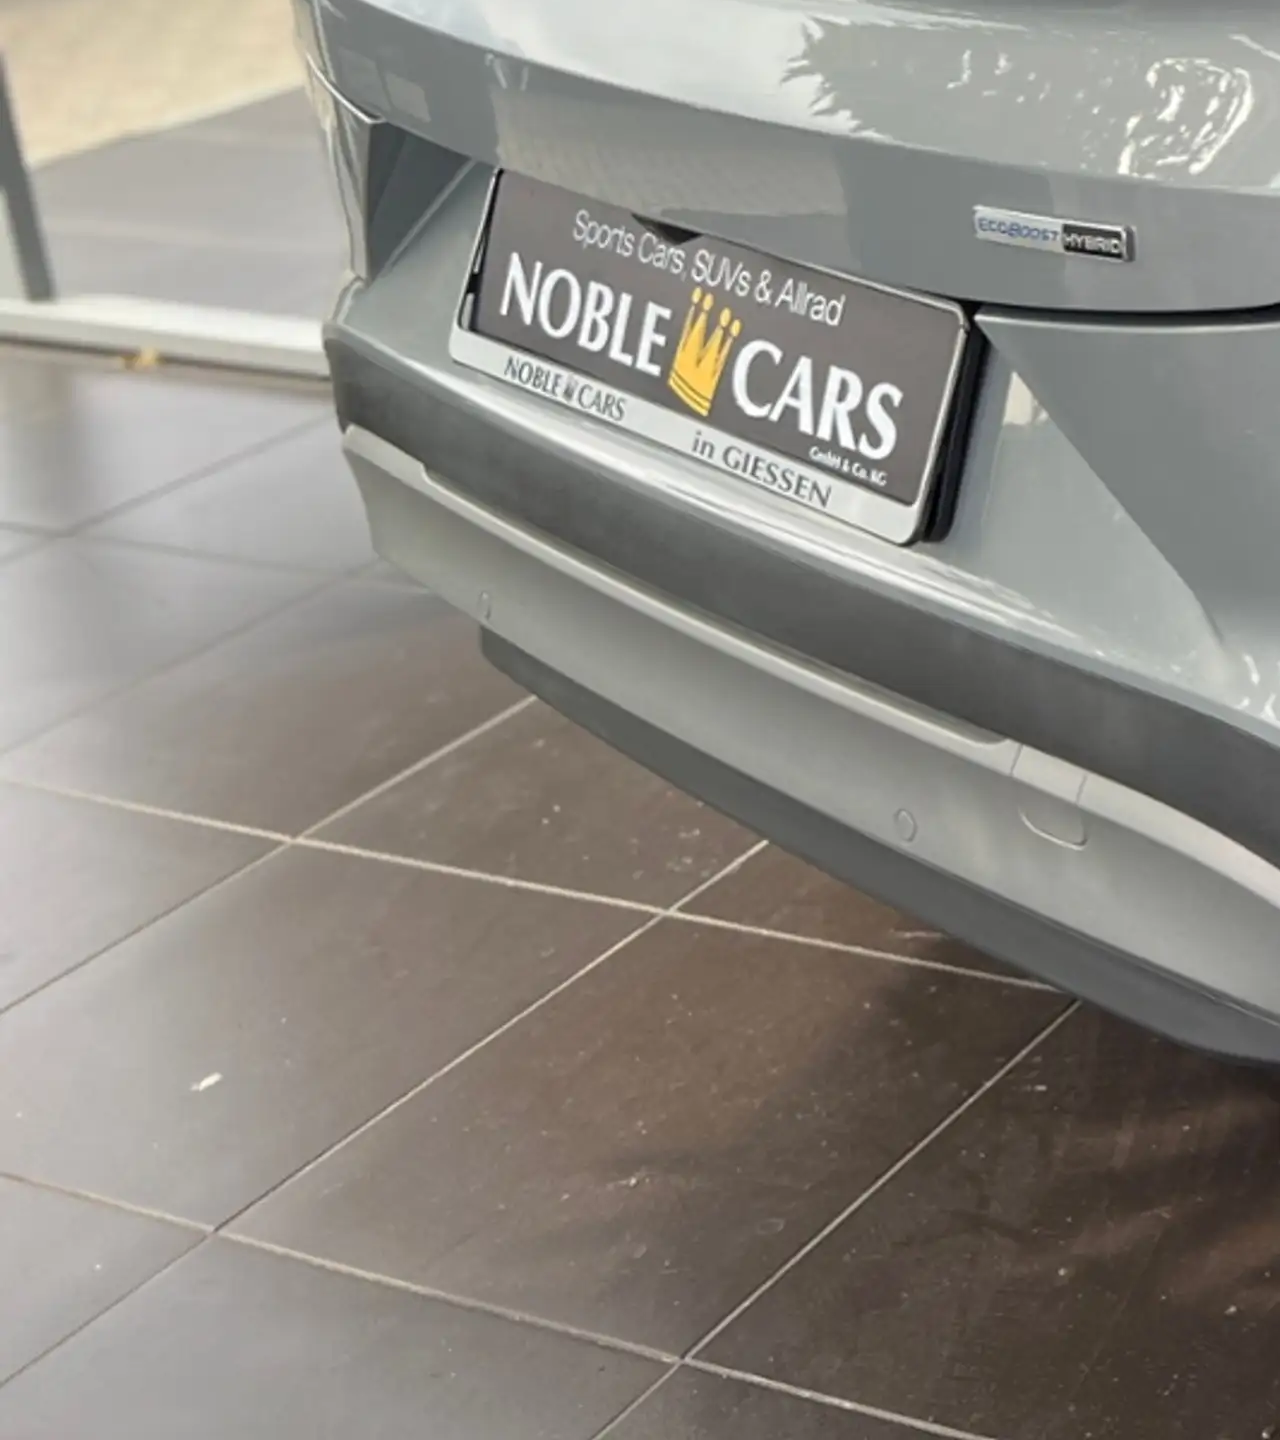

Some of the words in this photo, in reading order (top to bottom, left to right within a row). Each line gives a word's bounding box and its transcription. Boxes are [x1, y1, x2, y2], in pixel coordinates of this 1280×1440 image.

[572, 208, 636, 259] Sports
[638, 231, 688, 281] Cars,
[690, 248, 752, 298] SUVs
[754, 269, 775, 304] &
[775, 278, 846, 327] Allrad
[1063, 231, 1123, 254] HYBRID
[499, 251, 673, 376] NOBLE
[731, 339, 904, 460] CARS
[503, 355, 563, 397] NOBLE
[577, 382, 628, 422] CARS
[691, 430, 716, 459] in
[722, 444, 832, 509] GIESSEN
